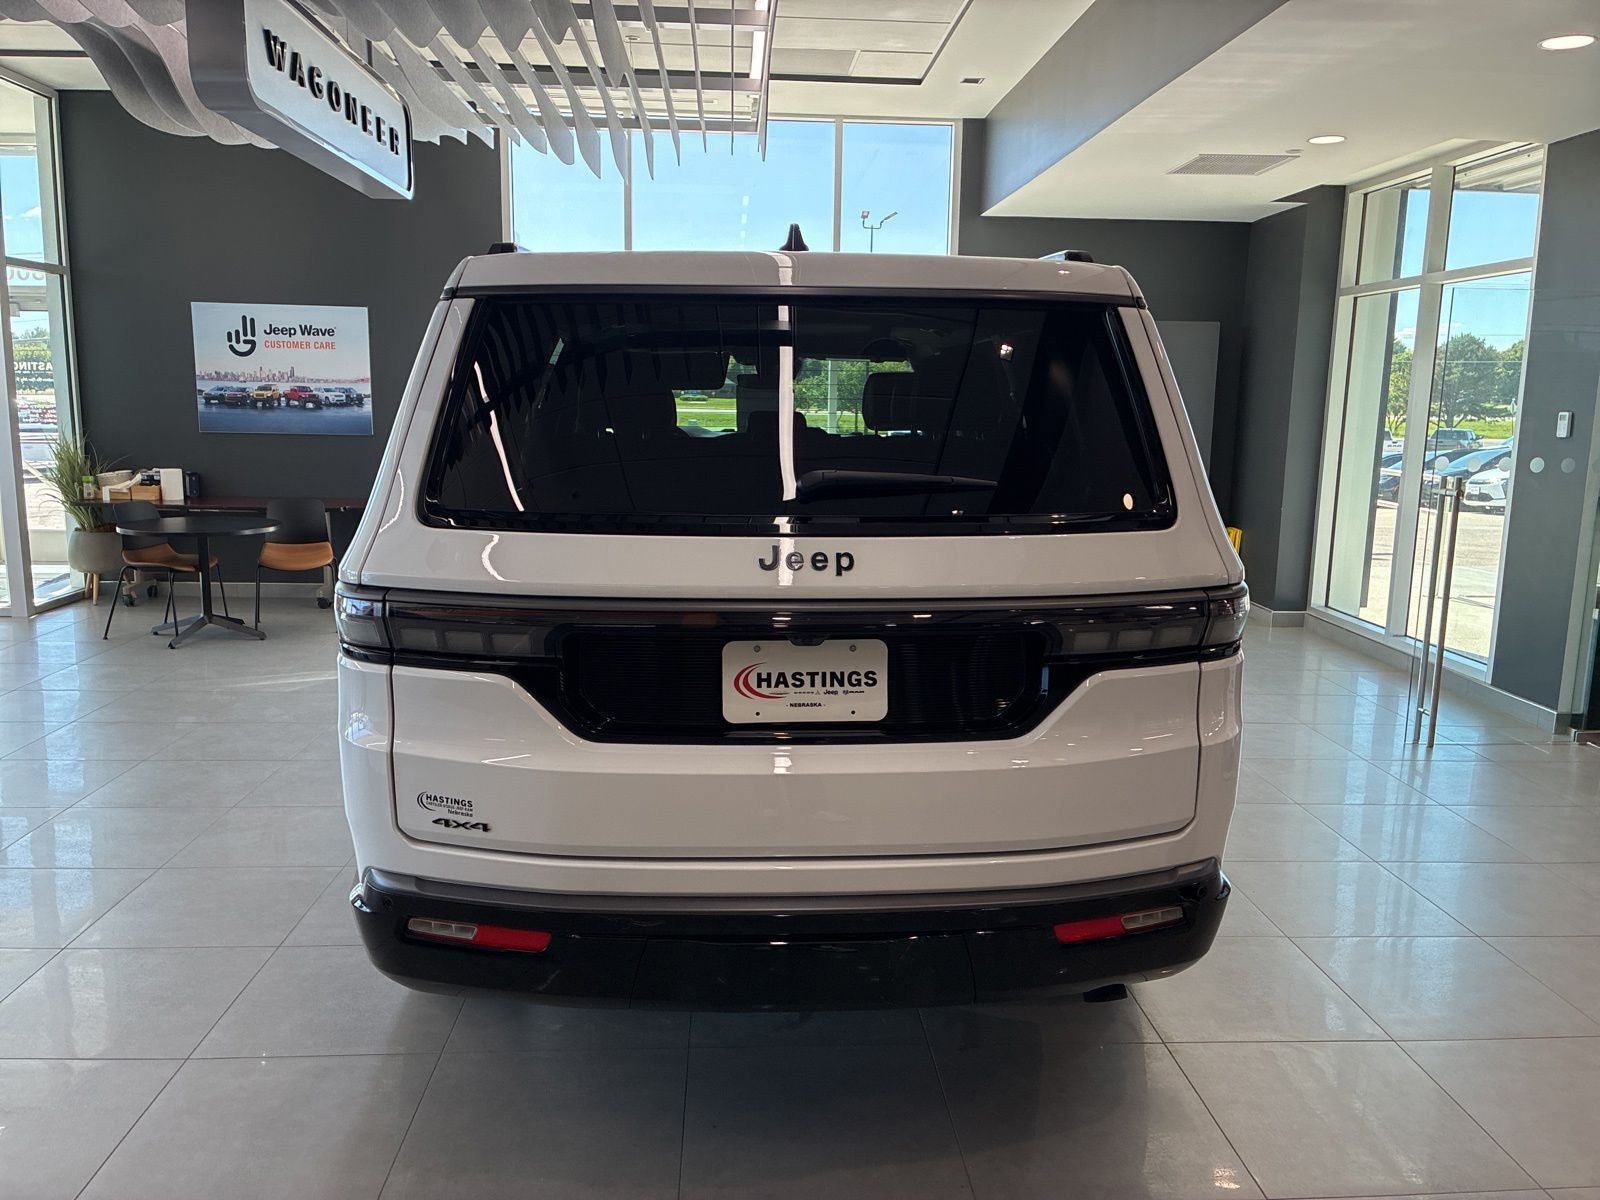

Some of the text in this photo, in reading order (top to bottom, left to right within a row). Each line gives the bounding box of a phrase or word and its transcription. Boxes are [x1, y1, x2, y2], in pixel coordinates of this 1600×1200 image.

[262, 28, 400, 155] WAGONEER
[263, 323, 335, 338] Jeep Wave
[264, 340, 336, 350] CUSTOMER CARE
[758, 545, 855, 576] Jeep
[756, 671, 878, 689] HASTINGS
[426, 794, 473, 807] HASTINGS
[447, 808, 473, 817] Nebraska
